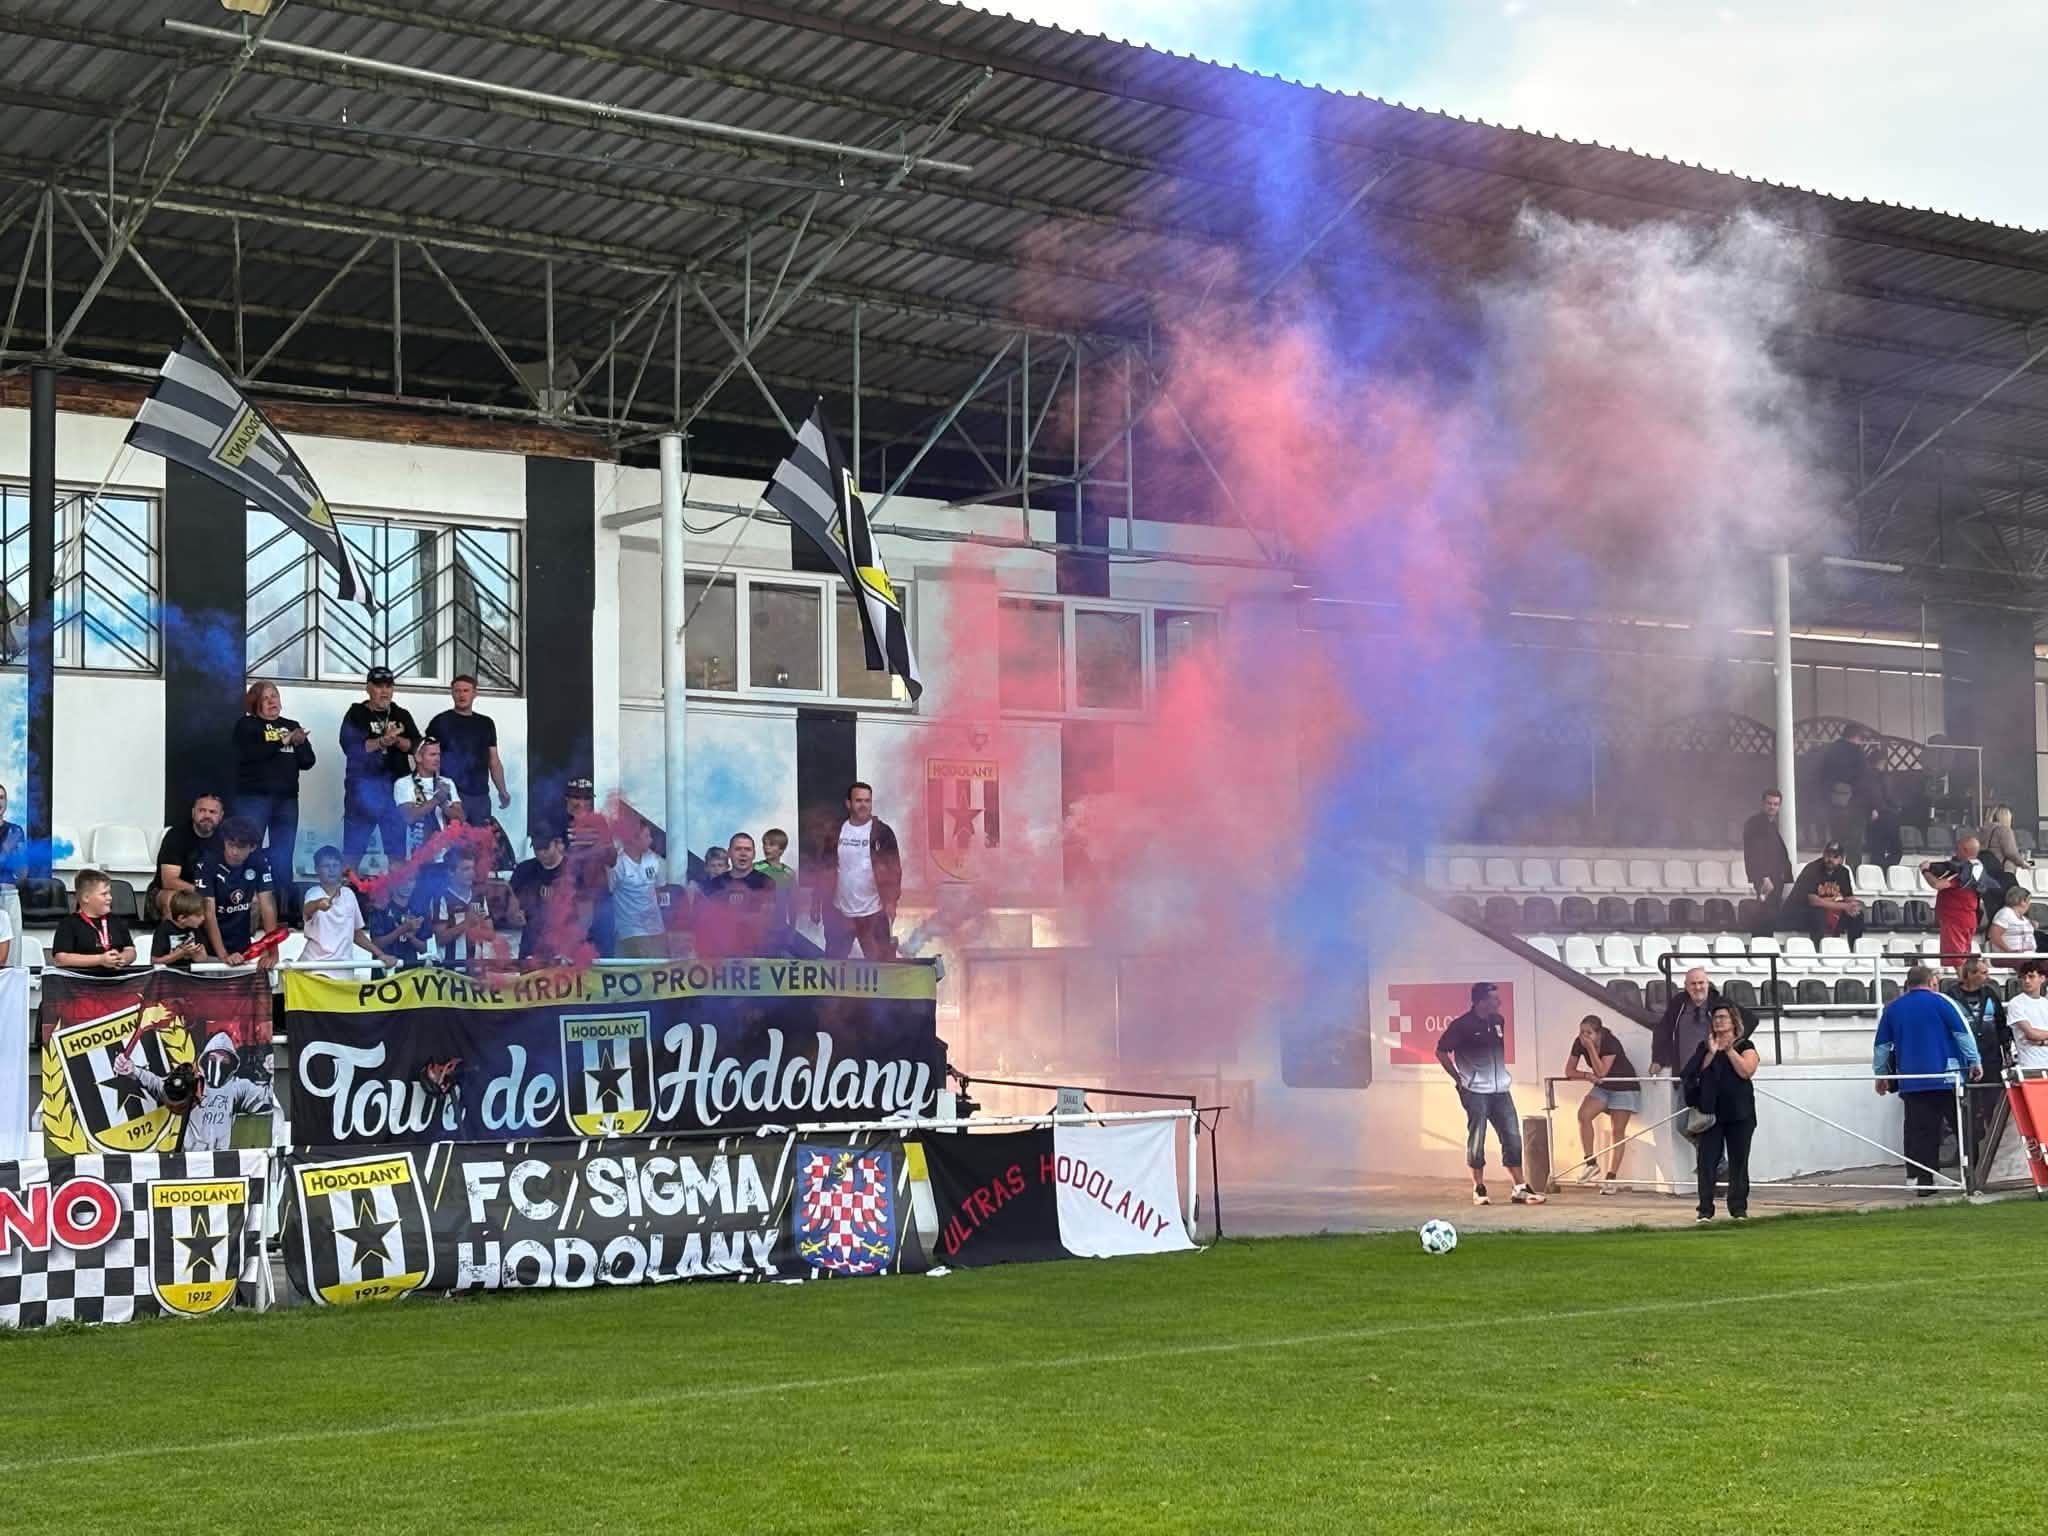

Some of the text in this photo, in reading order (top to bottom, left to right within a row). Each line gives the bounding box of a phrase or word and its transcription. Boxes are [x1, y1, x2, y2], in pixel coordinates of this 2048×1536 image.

[933, 763, 993, 778] HODOLANY
[359, 980, 401, 1006] PO
[602, 973, 642, 997] PO
[770, 961, 845, 991] VĚRNÍ
[856, 967, 879, 992] !!!
[69, 1018, 139, 1053] HODOLAN
[571, 1022, 640, 1038] HODOLANY
[1425, 1015, 1459, 1033] OLO
[482, 1045, 560, 1130] de
[658, 1022, 938, 1127] Hodolany
[127, 1121, 153, 1142] 1912
[202, 1111, 225, 1125] 1912
[311, 1165, 402, 1192] HODOLANY
[462, 1154, 770, 1223] FC SIGMA
[160, 1188, 239, 1204] HODOLANY
[942, 1152, 1171, 1257] ULTRAS HODOLANY
[456, 1228, 780, 1290] HODOLANY
[186, 1290, 213, 1304] 1912
